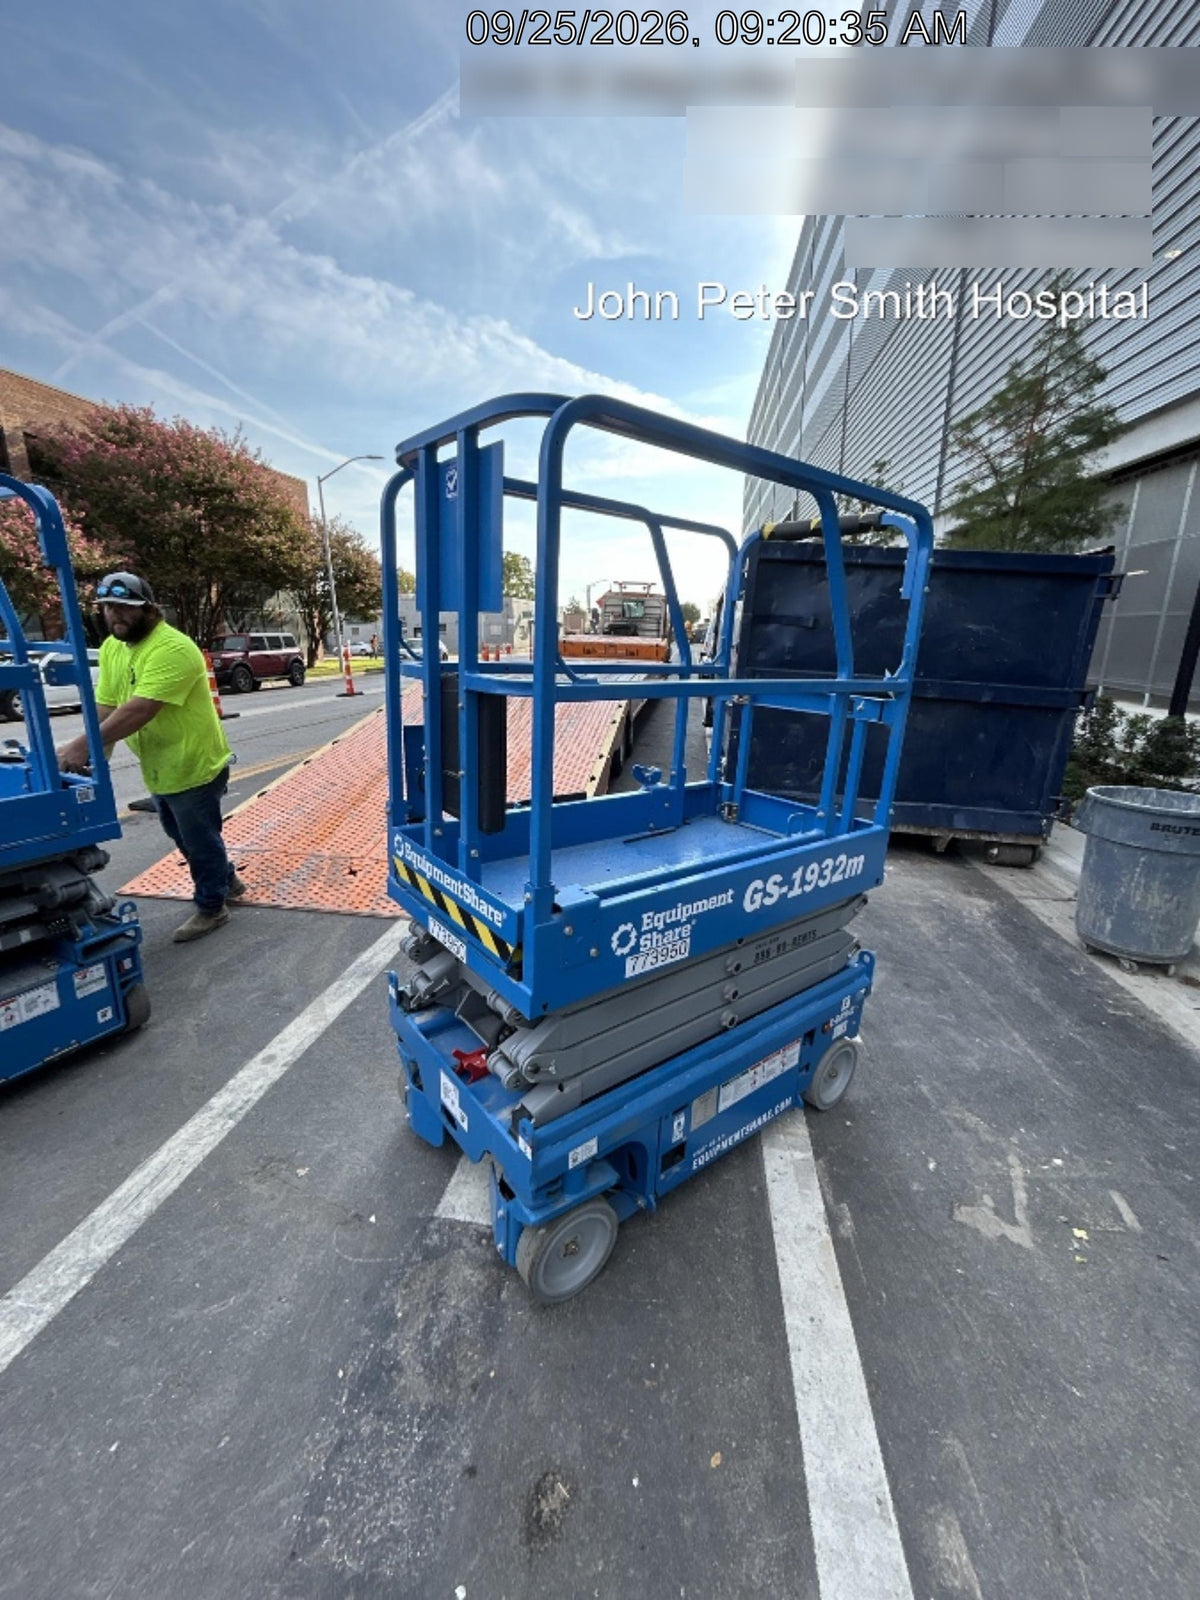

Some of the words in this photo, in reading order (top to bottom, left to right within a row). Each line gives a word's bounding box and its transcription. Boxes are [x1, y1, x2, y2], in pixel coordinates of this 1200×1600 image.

[1150, 822, 1200, 836] BRUTE
[403, 841, 503, 929] EquipmentShare
[742, 853, 866, 913] GS-1932m
[641, 887, 735, 931] Equipment
[630, 940, 688, 973] 773950
[640, 923, 691, 953] Share
